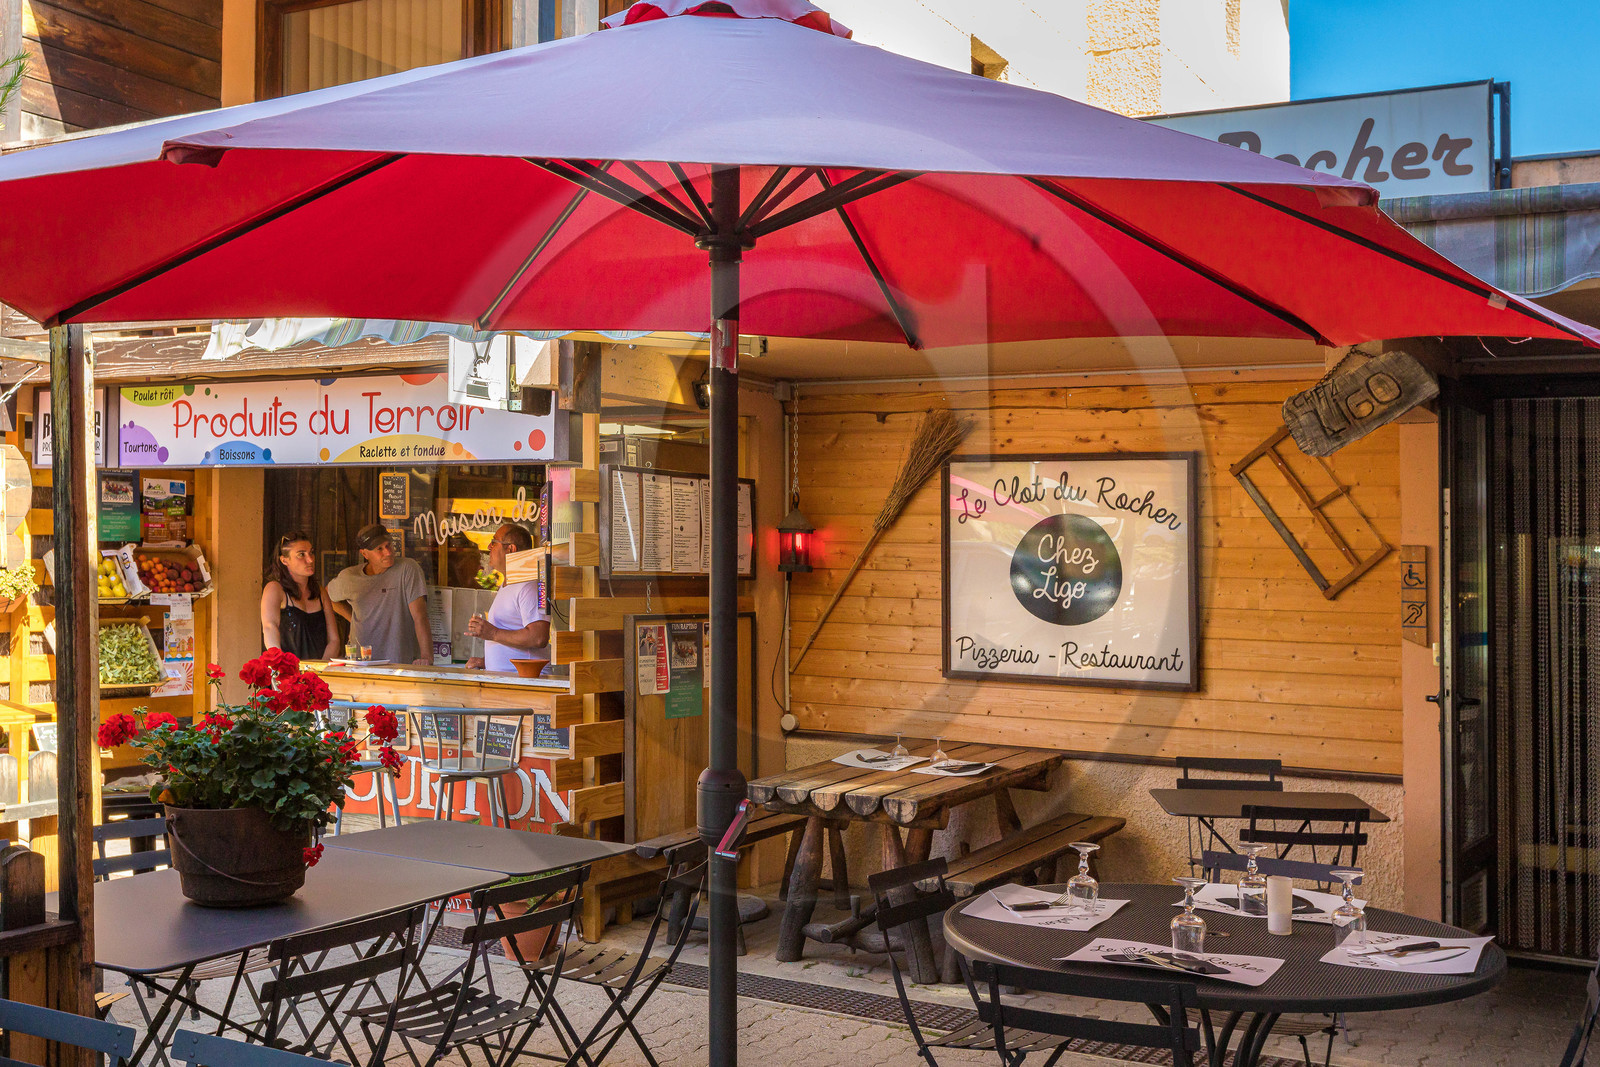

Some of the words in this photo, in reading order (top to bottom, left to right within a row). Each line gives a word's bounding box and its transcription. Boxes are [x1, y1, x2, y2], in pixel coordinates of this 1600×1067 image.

[133, 390, 158, 402] Poulet
[160, 388, 174, 401] rôti
[1292, 378, 1339, 409] CHEZ
[1301, 371, 1402, 440] LIGO
[172, 396, 298, 439] Produits
[309, 394, 350, 436] du
[361, 391, 485, 434] Terroir
[123, 441, 158, 453] Tourtons
[219, 449, 256, 461] Boissons
[359, 445, 397, 458] Raclette
[400, 446, 411, 458] et
[413, 445, 446, 457] fondue
[413, 506, 503, 546] Maison
[511, 486, 541, 523] de
[955, 488, 987, 525] Le
[993, 475, 1046, 507] Clot
[1053, 471, 1087, 501] du
[1096, 476, 1182, 532] Rocher
[1037, 533, 1099, 574] Chez
[1033, 566, 1087, 610] Ligo
[955, 636, 1040, 670] Pizzeria
[1061, 641, 1184, 672] Restaurant
[1205, 955, 1267, 974] Rocher
